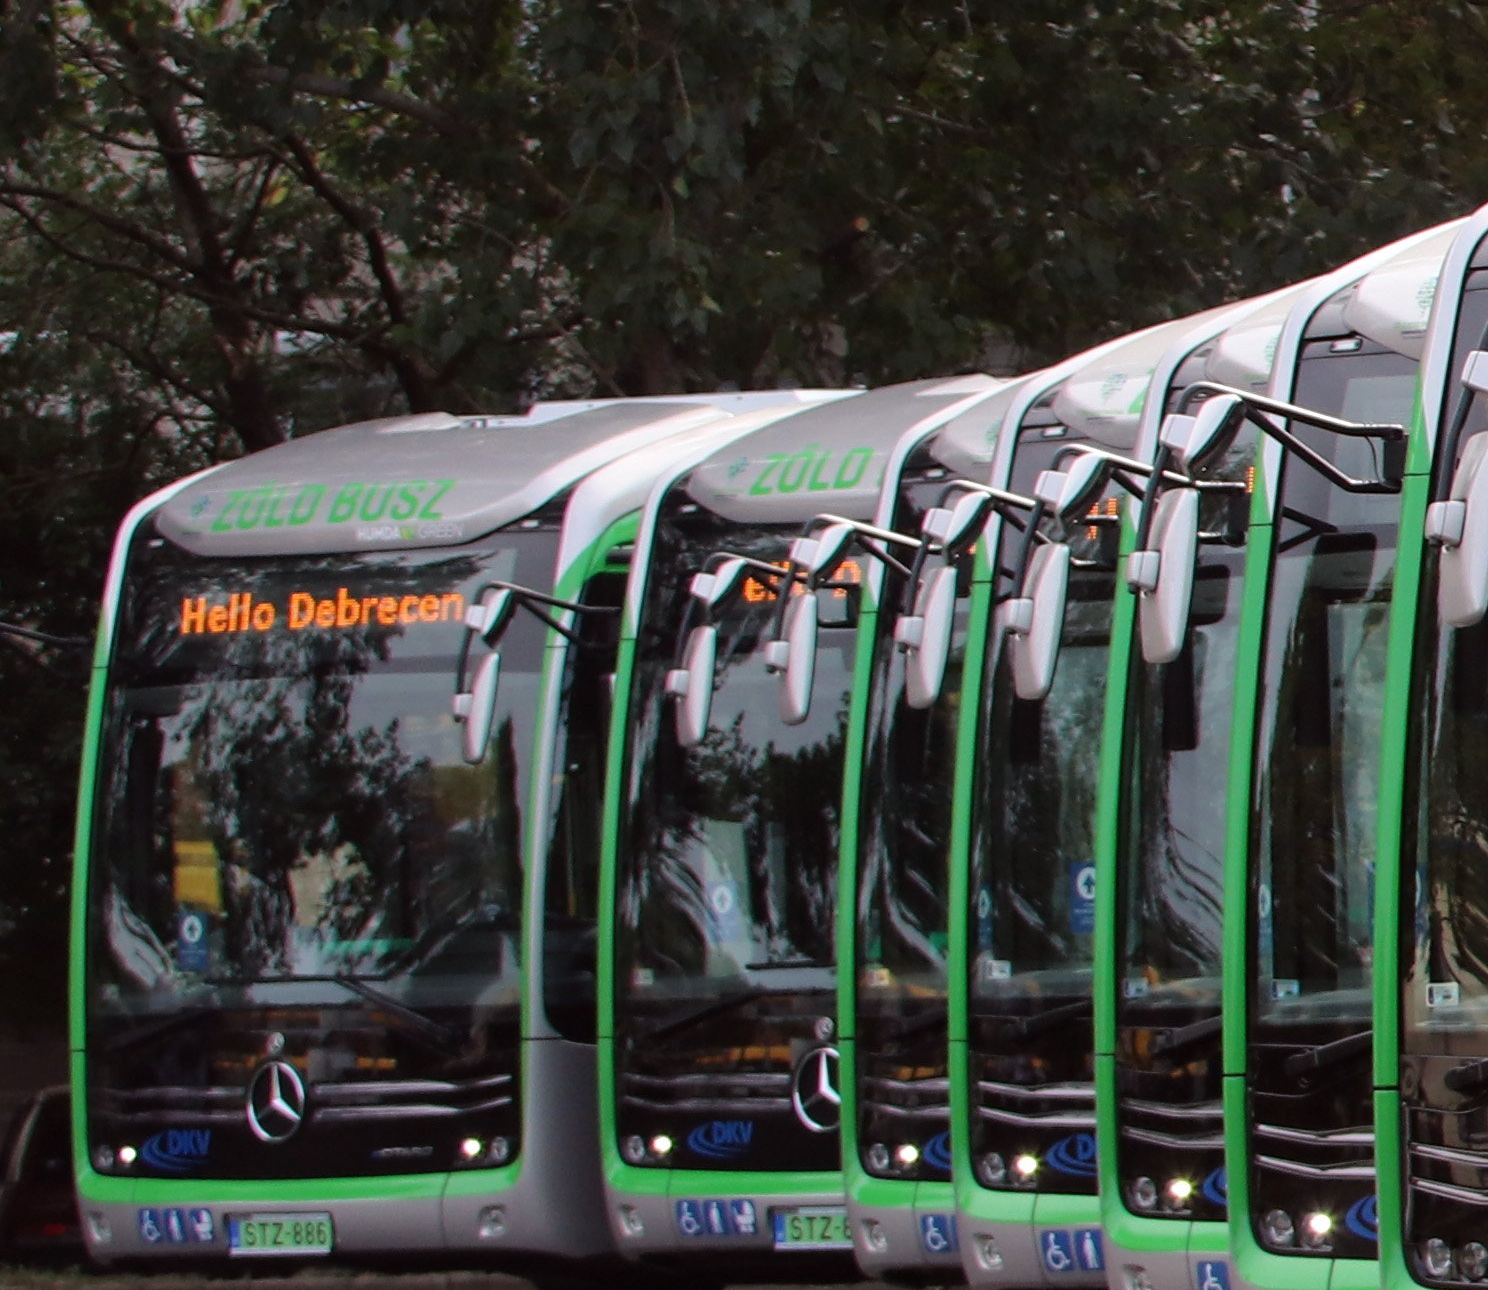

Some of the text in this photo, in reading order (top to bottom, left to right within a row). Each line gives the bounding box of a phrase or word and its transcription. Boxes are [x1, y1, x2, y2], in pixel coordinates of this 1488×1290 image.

[749, 442, 875, 496] ZÖLD
[210, 478, 456, 532] ZÖLD BUSZ
[180, 587, 464, 635] Hello Debrecen
[168, 1129, 211, 1156] DKV
[712, 1120, 754, 1144] DKV
[245, 1222, 327, 1246] STZ-886
[790, 1215, 852, 1240] STZ-8
